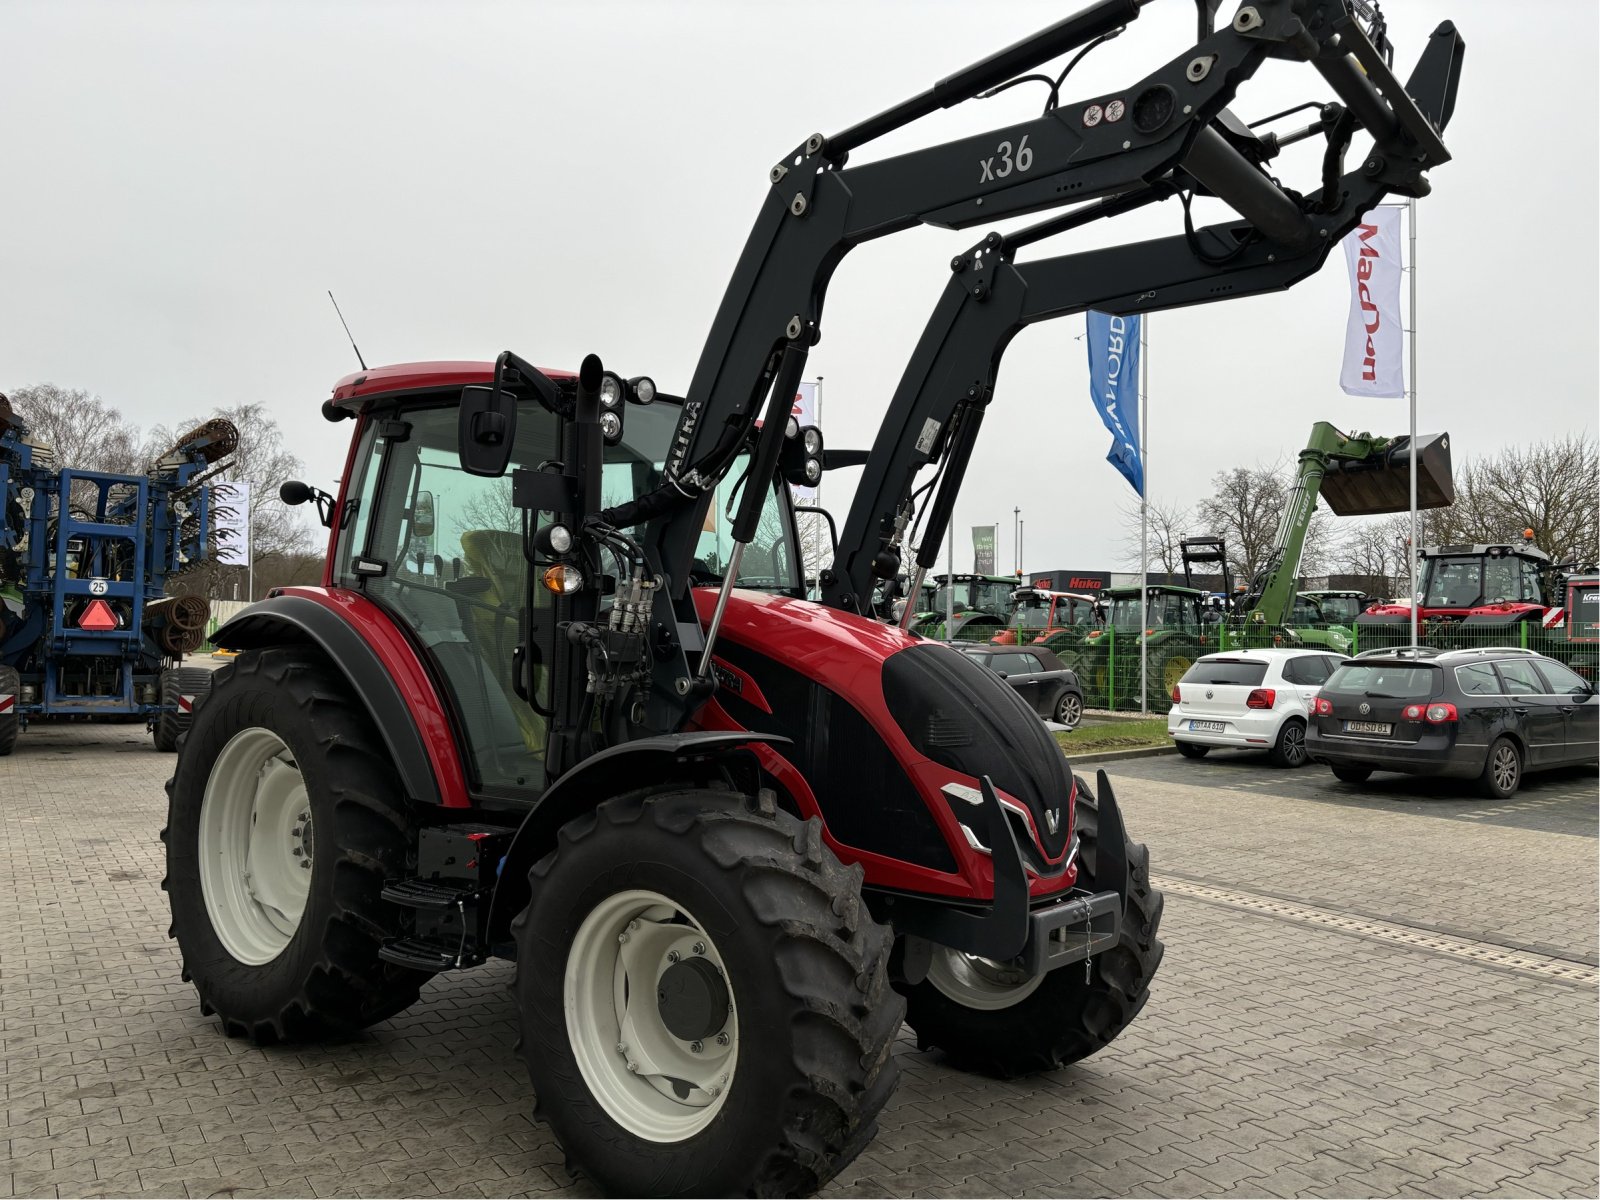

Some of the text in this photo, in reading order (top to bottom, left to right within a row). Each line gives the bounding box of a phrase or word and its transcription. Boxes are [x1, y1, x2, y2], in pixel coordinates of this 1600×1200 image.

[979, 134, 1033, 184] x36
[93, 583, 104, 593] 25
[1069, 577, 1102, 589] Hako
